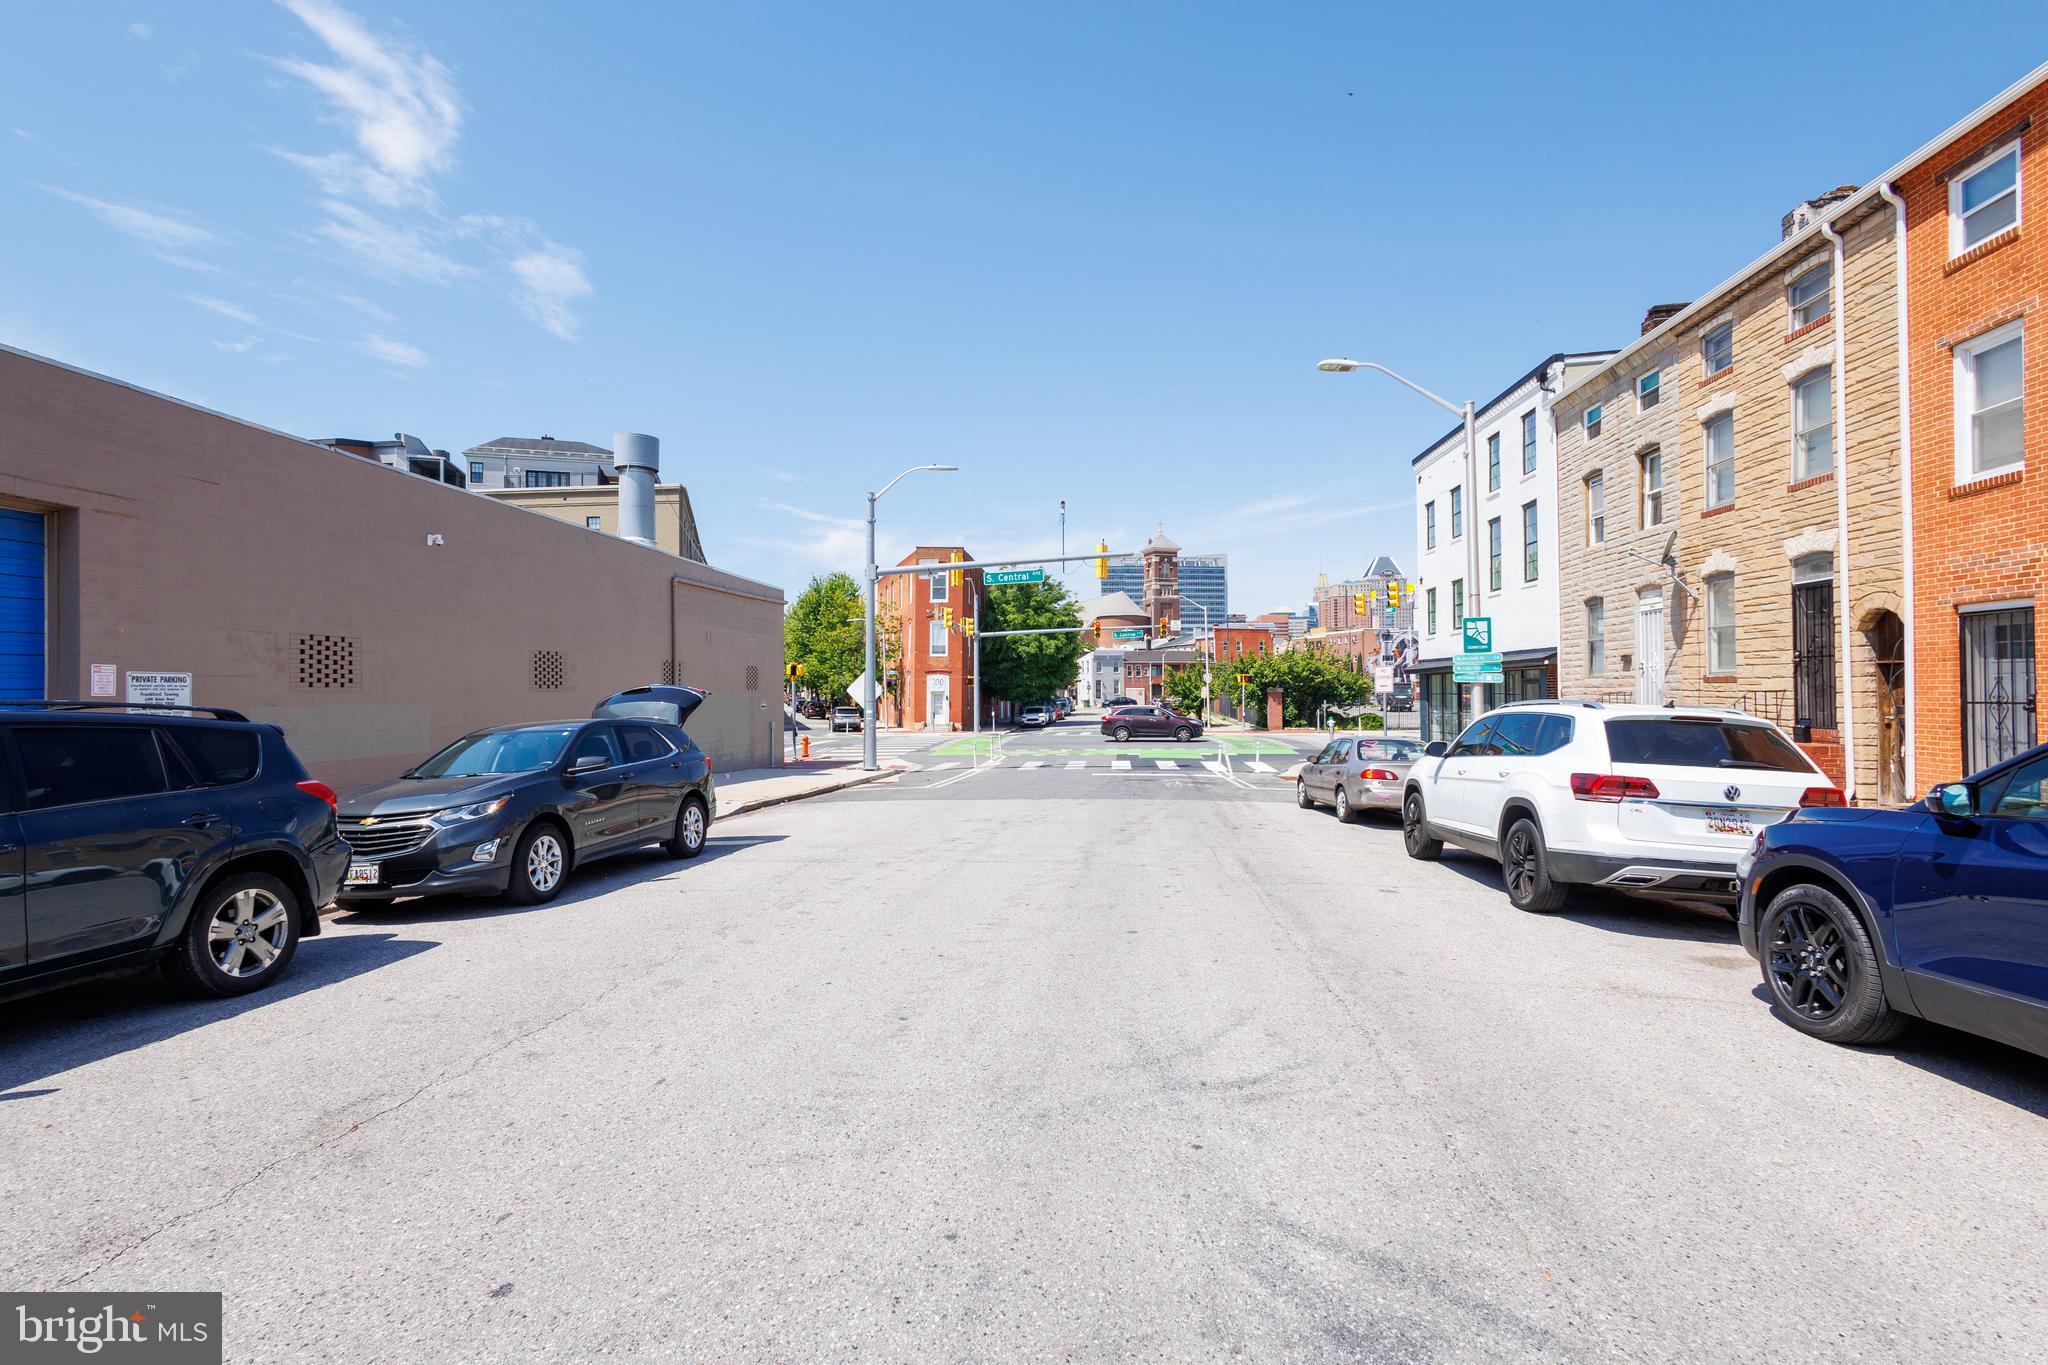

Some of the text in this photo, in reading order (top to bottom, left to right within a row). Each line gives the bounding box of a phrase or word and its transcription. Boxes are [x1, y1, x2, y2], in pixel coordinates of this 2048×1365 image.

[998, 573, 1029, 582] Central
[131, 675, 188, 684] PRIVATE PARKING
[348, 868, 378, 879] FA8512
